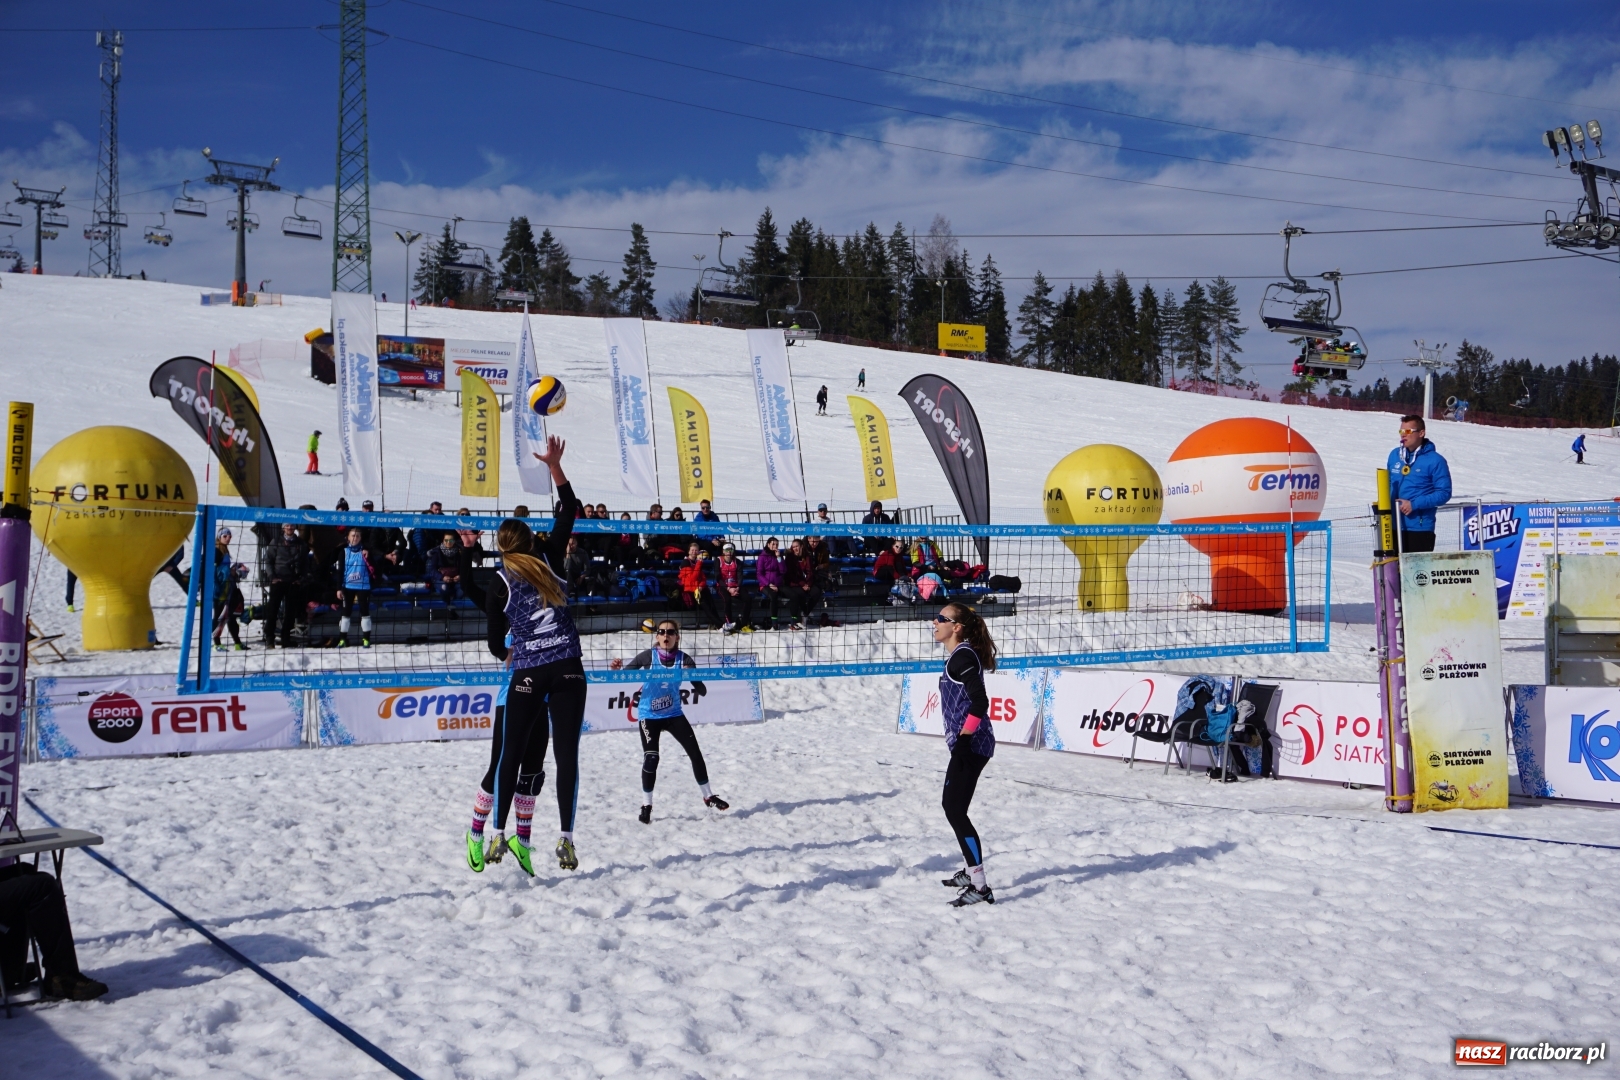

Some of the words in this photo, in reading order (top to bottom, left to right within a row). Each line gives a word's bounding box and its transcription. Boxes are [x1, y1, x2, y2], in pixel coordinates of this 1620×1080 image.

[950, 329, 969, 337] RMF
[427, 372, 439, 381] 35
[12, 424, 25, 476] SPORT
[54, 482, 184, 503] FORTUNA
[1086, 485, 1163, 502] FORTUNA
[65, 506, 125, 520] zakłady
[1094, 505, 1137, 514] zakłady
[1431, 568, 1480, 577] SIATKÓWKA
[1431, 577, 1472, 585] PLAŻOWA
[530, 607, 558, 635] 2
[1438, 661, 1487, 671] SIATKÓWKA
[1439, 671, 1479, 680] PLAŻOWA
[661, 681, 669, 689] 2
[371, 686, 493, 719] Terma
[92, 706, 139, 718] SPORT
[151, 695, 247, 735] rent
[97, 718, 135, 729] 2000
[1080, 709, 1170, 734] rhSPORT
[1443, 748, 1492, 758] SIATKÓWKA
[1445, 757, 1484, 767] PLAŻOWA
